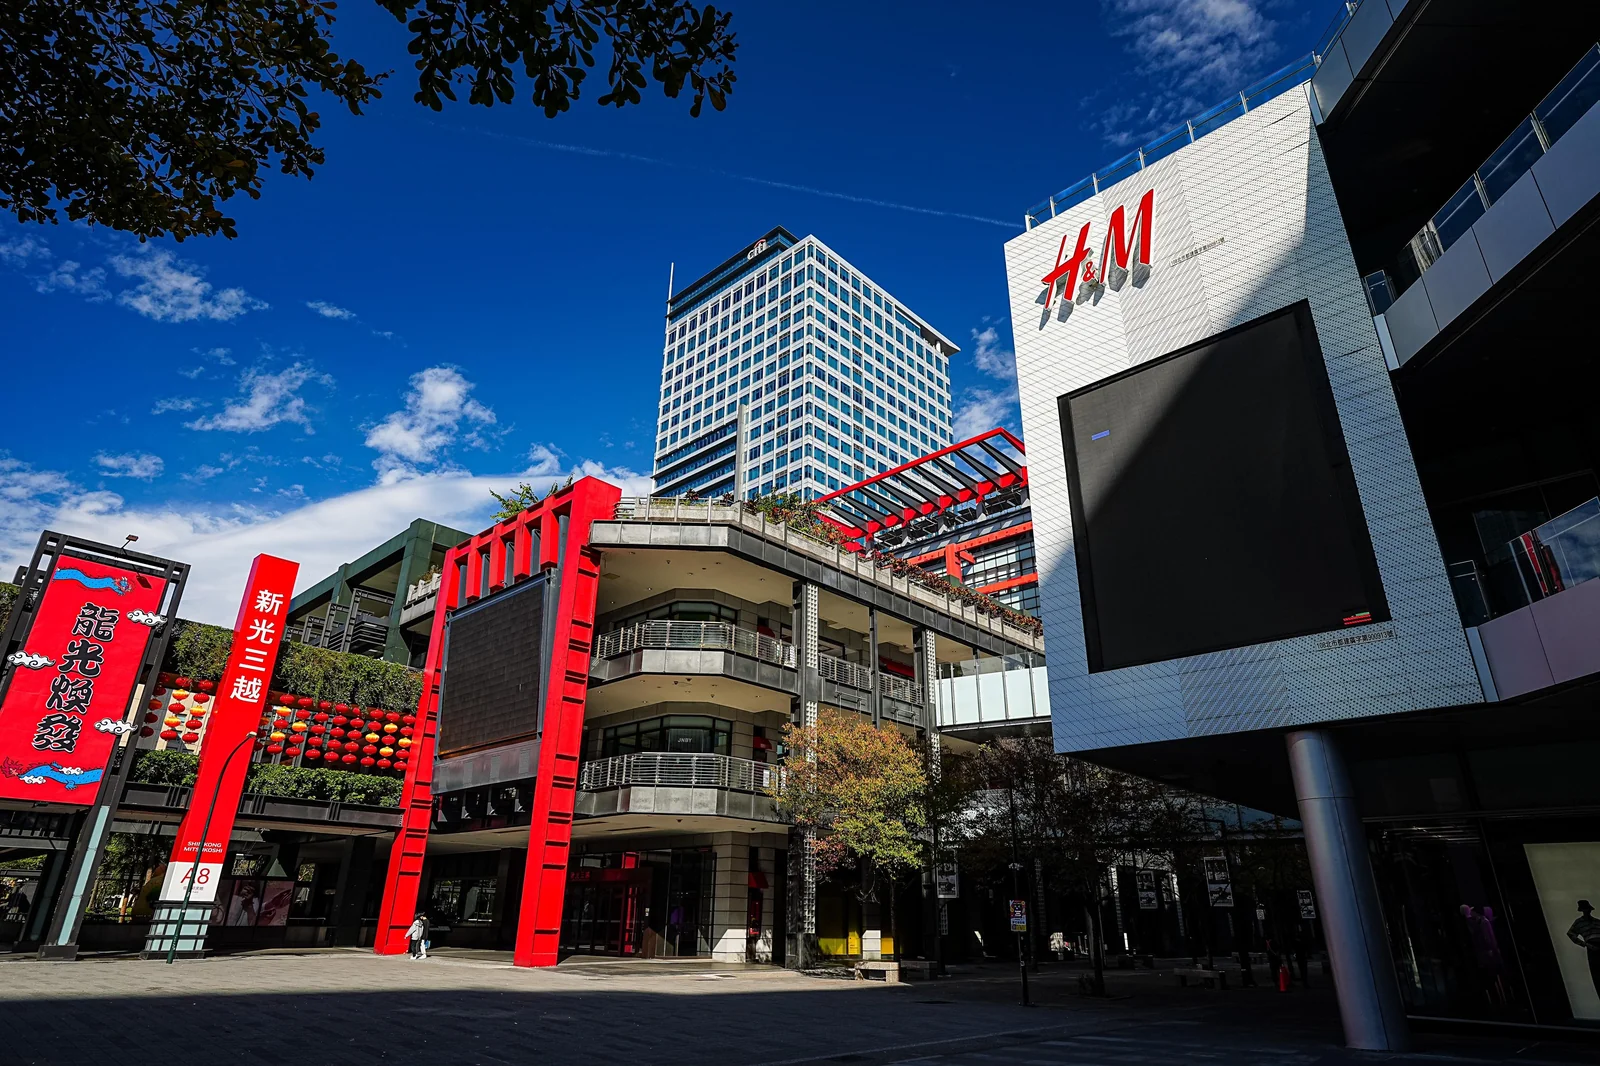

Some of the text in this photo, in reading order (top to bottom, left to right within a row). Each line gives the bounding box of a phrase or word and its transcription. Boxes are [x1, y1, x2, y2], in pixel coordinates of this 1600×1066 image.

[747, 240, 768, 260] citi
[1040, 188, 1154, 309] H&M
[31, 602, 120, 753] 龍光煥發
[230, 589, 284, 703] 新光三越
[180, 867, 211, 885] A8
